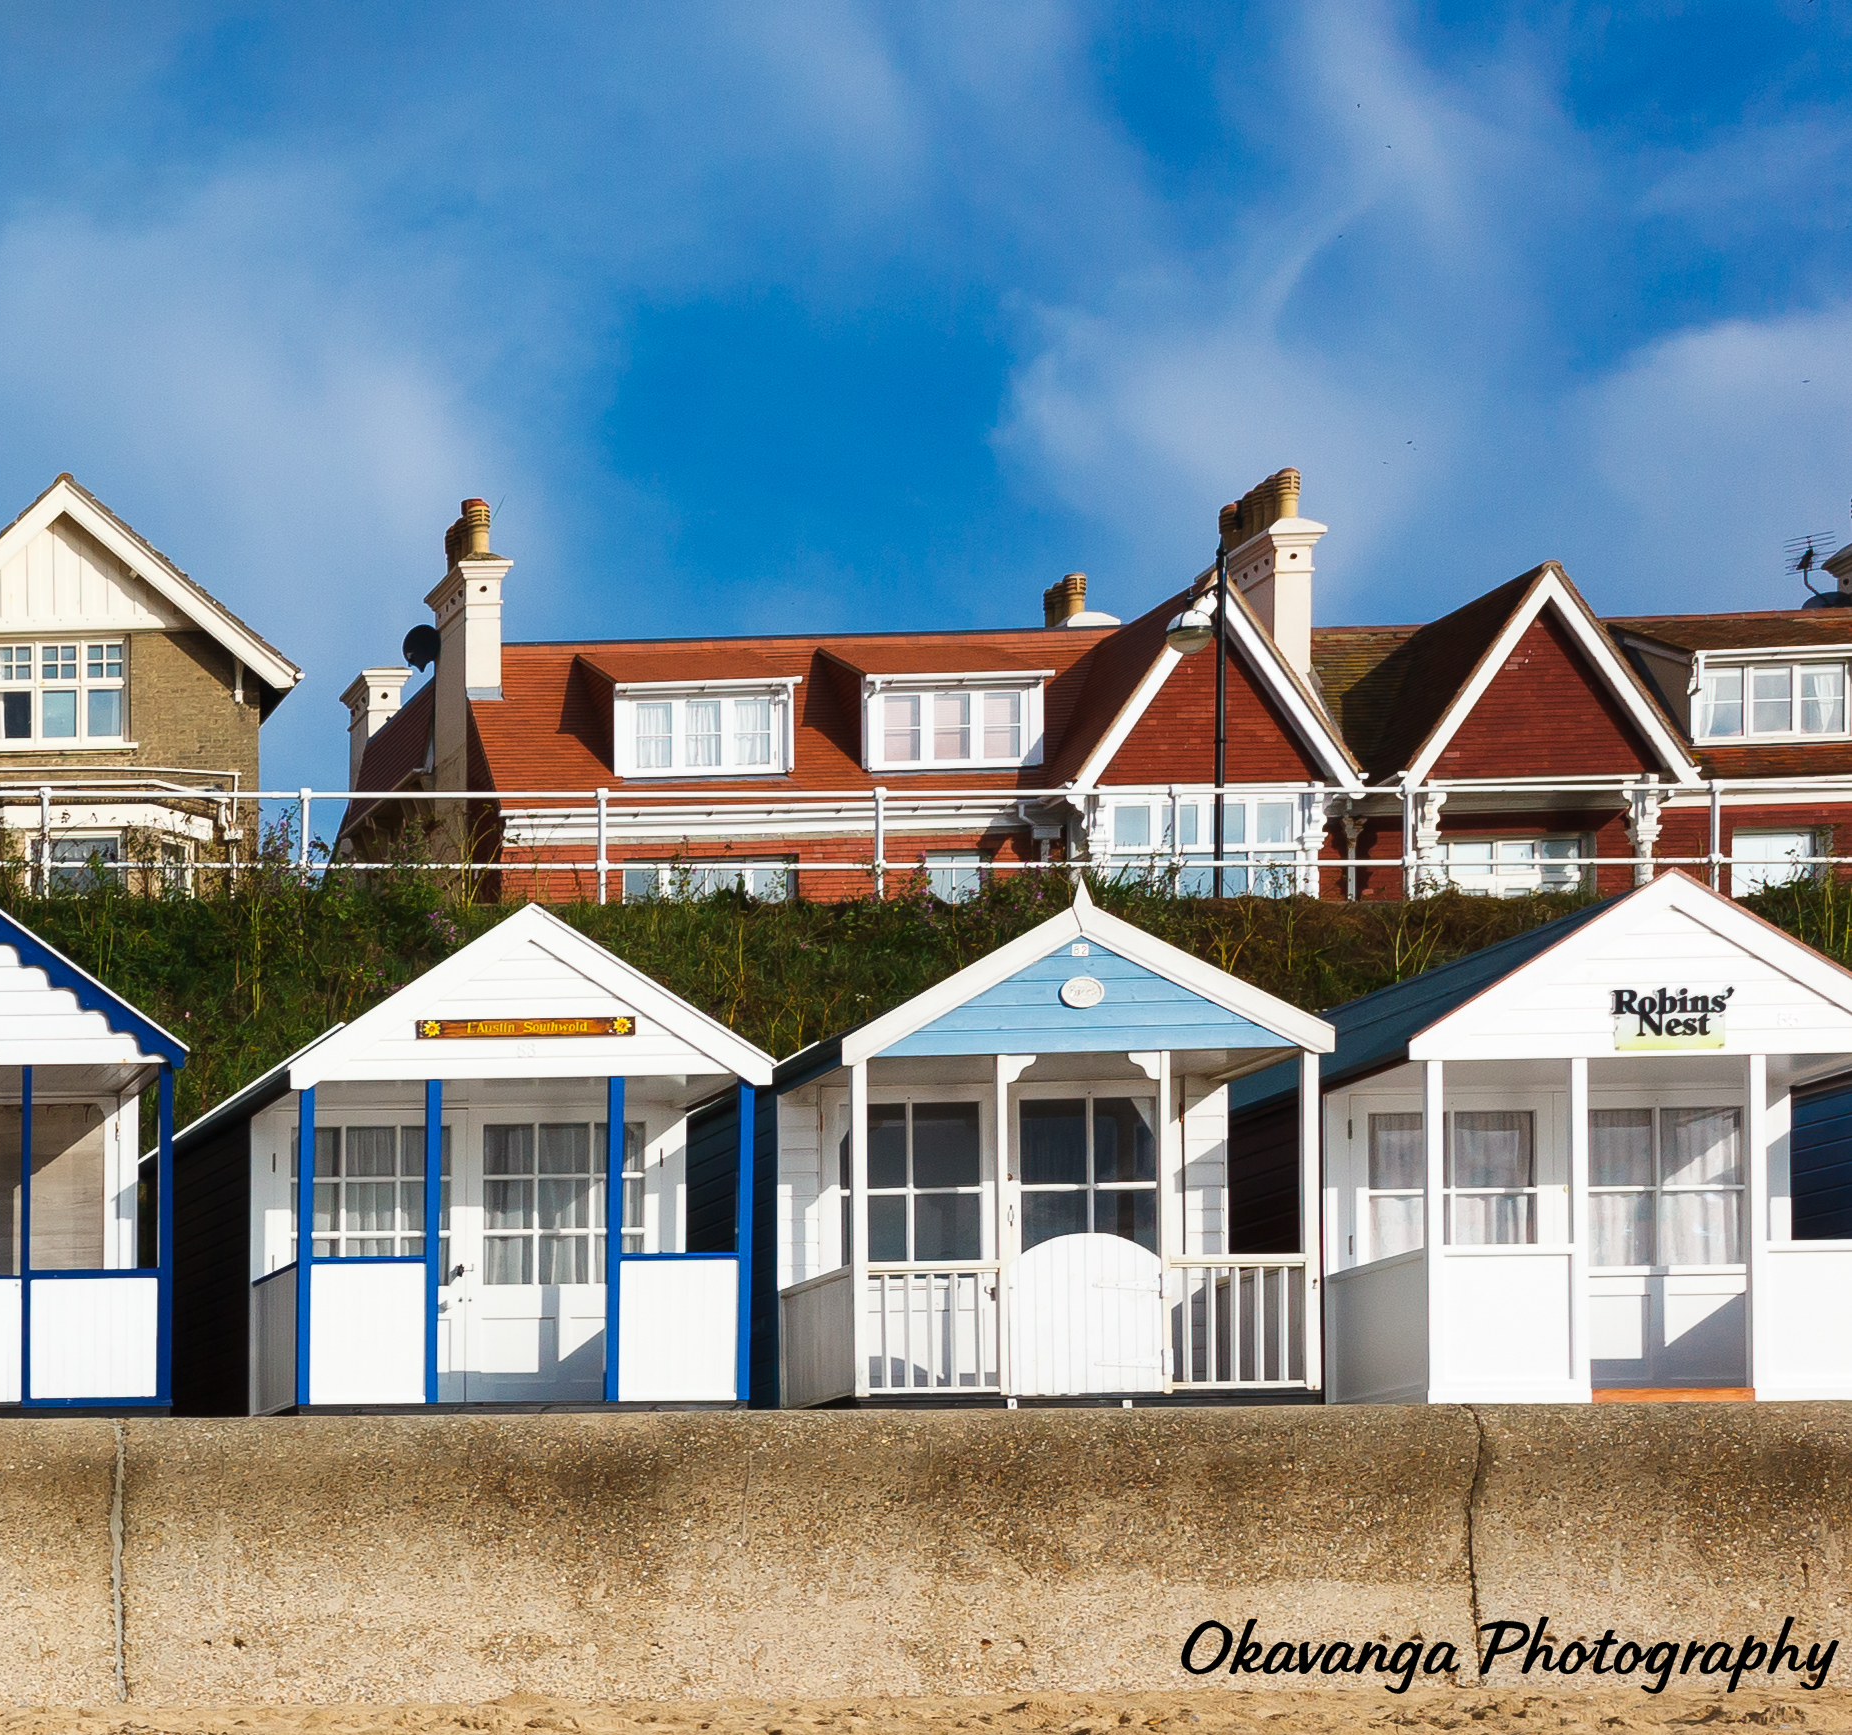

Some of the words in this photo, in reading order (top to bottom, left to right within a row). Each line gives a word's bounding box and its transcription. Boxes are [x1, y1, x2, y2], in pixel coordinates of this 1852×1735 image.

[1074, 945, 1088, 955] 82
[1611, 986, 1735, 1015] Robins'
[523, 1020, 588, 1033] Southwold
[1636, 1009, 1711, 1037] Nest
